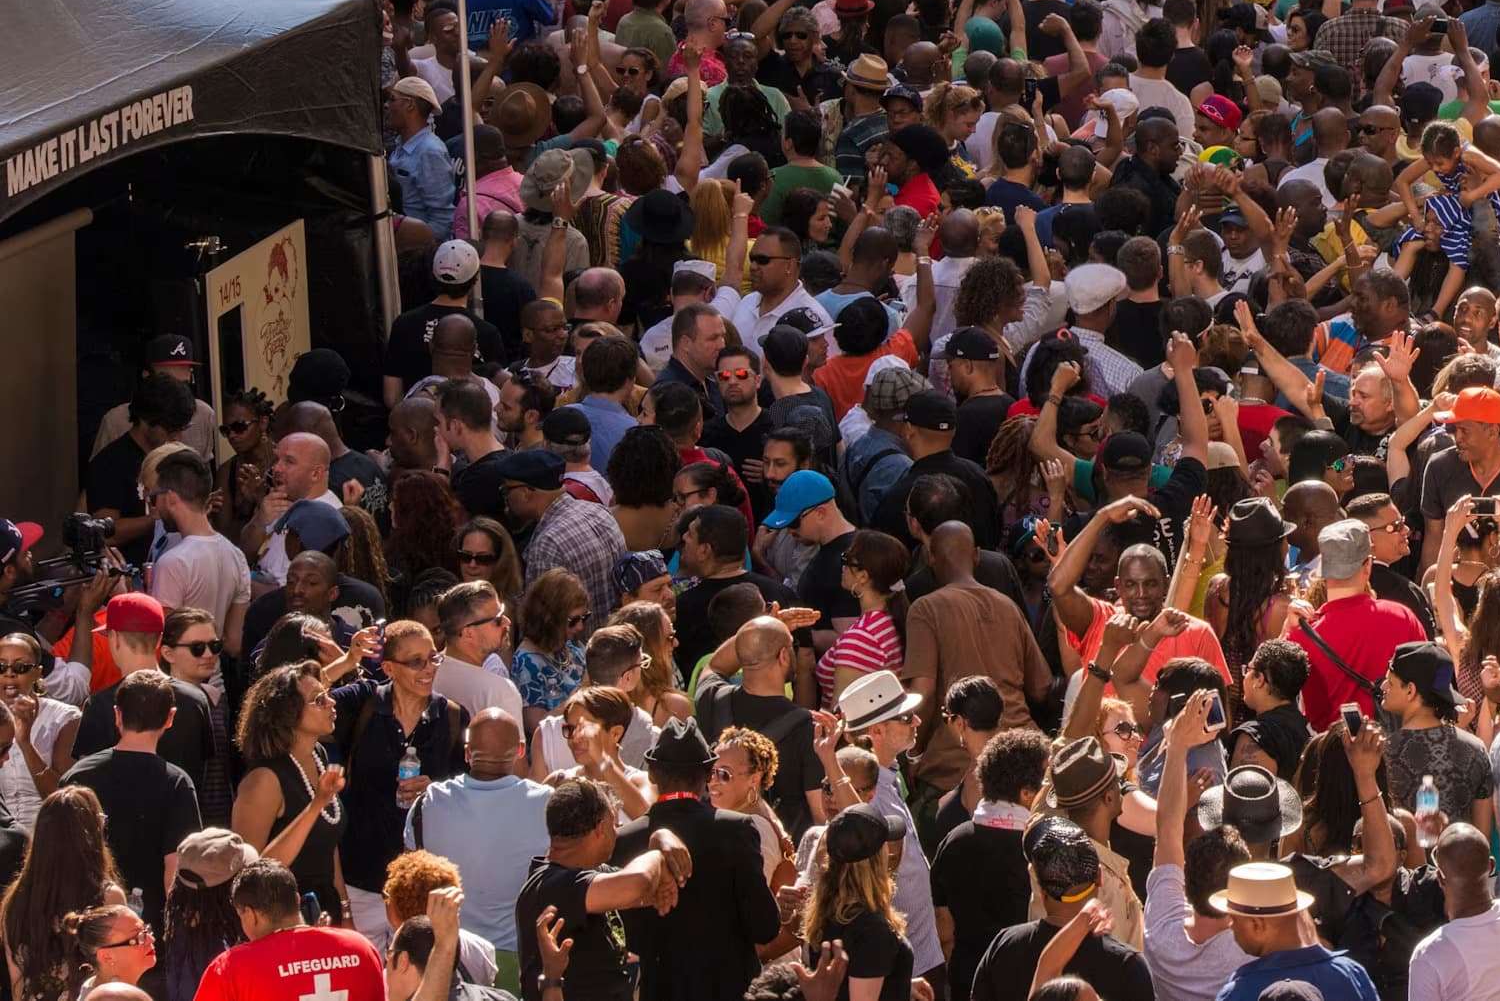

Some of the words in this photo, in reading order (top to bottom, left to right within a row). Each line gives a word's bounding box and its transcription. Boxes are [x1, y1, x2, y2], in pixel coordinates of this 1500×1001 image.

[467, 8, 512, 35] NIKE
[7, 137, 59, 197] MAKE
[60, 129, 77, 173] IT
[79, 110, 119, 163] LAST
[122, 85, 194, 144] FOREVER
[278, 955, 360, 977] LIFEGUARD
